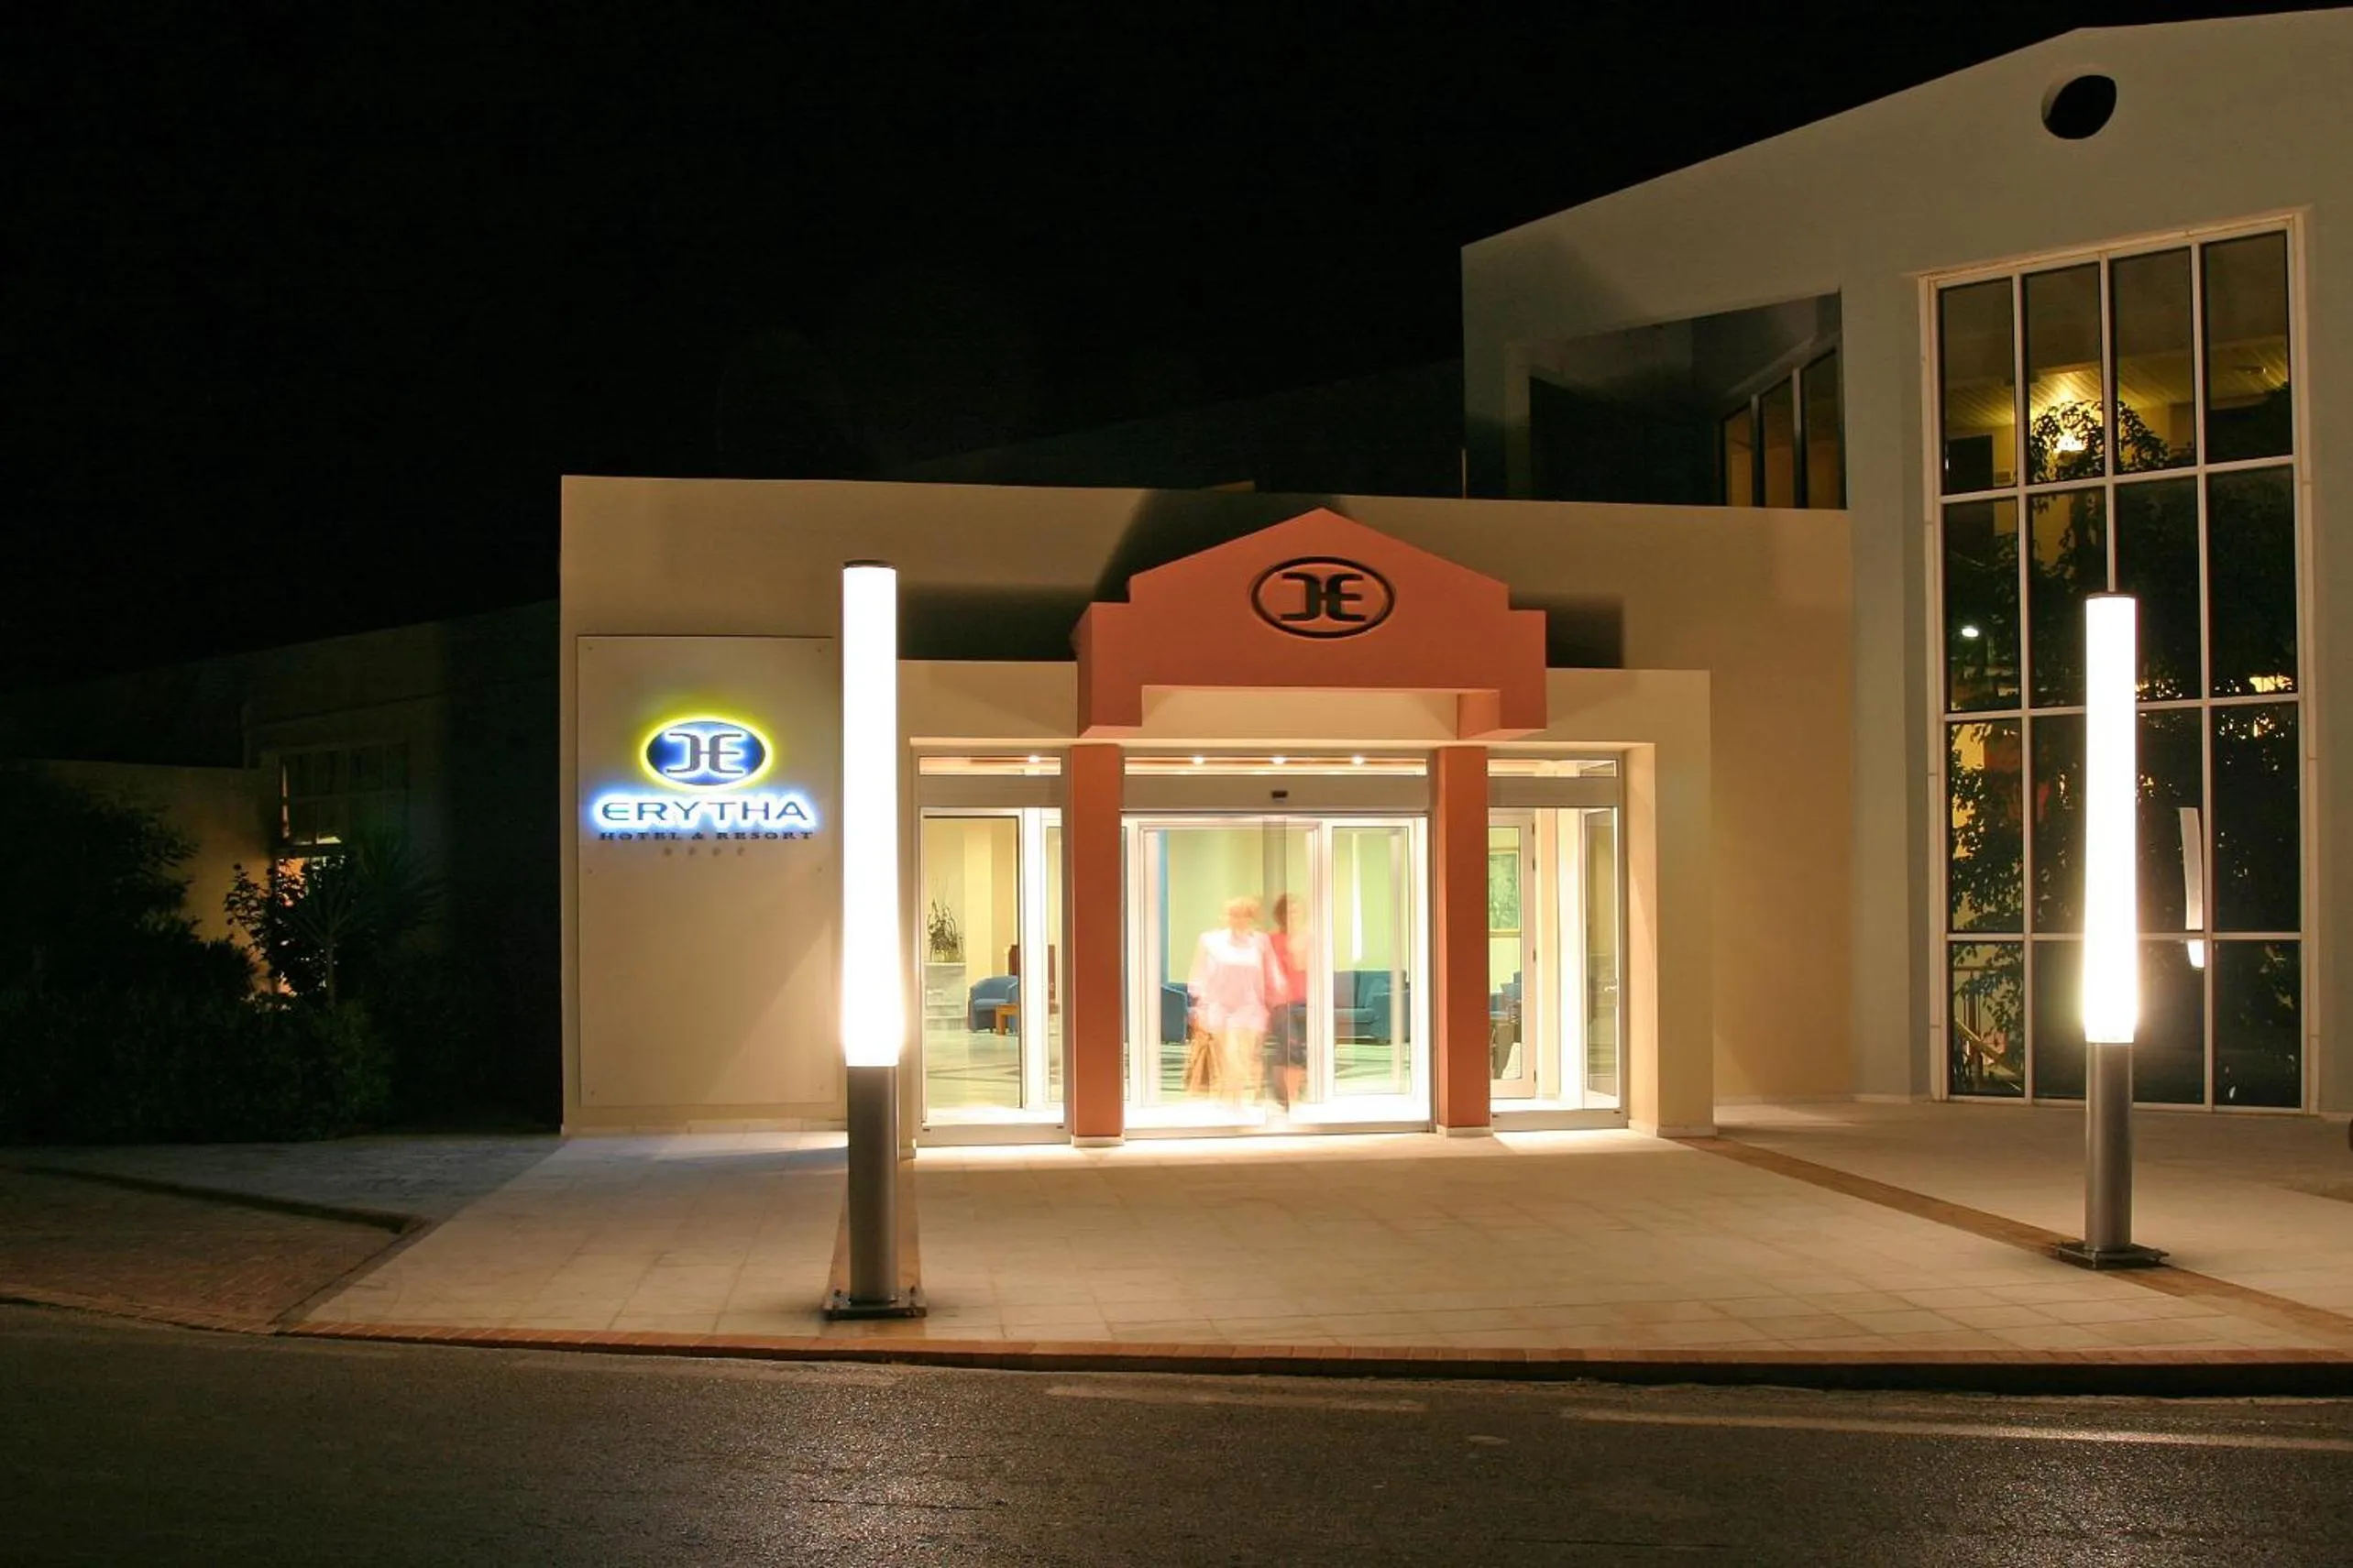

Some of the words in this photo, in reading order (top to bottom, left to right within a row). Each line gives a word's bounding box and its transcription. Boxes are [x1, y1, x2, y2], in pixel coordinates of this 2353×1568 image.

[601, 801, 808, 821] ERYTHA
[599, 831, 682, 841] HOTEL
[692, 831, 704, 841] &
[716, 831, 813, 840] RESORT
